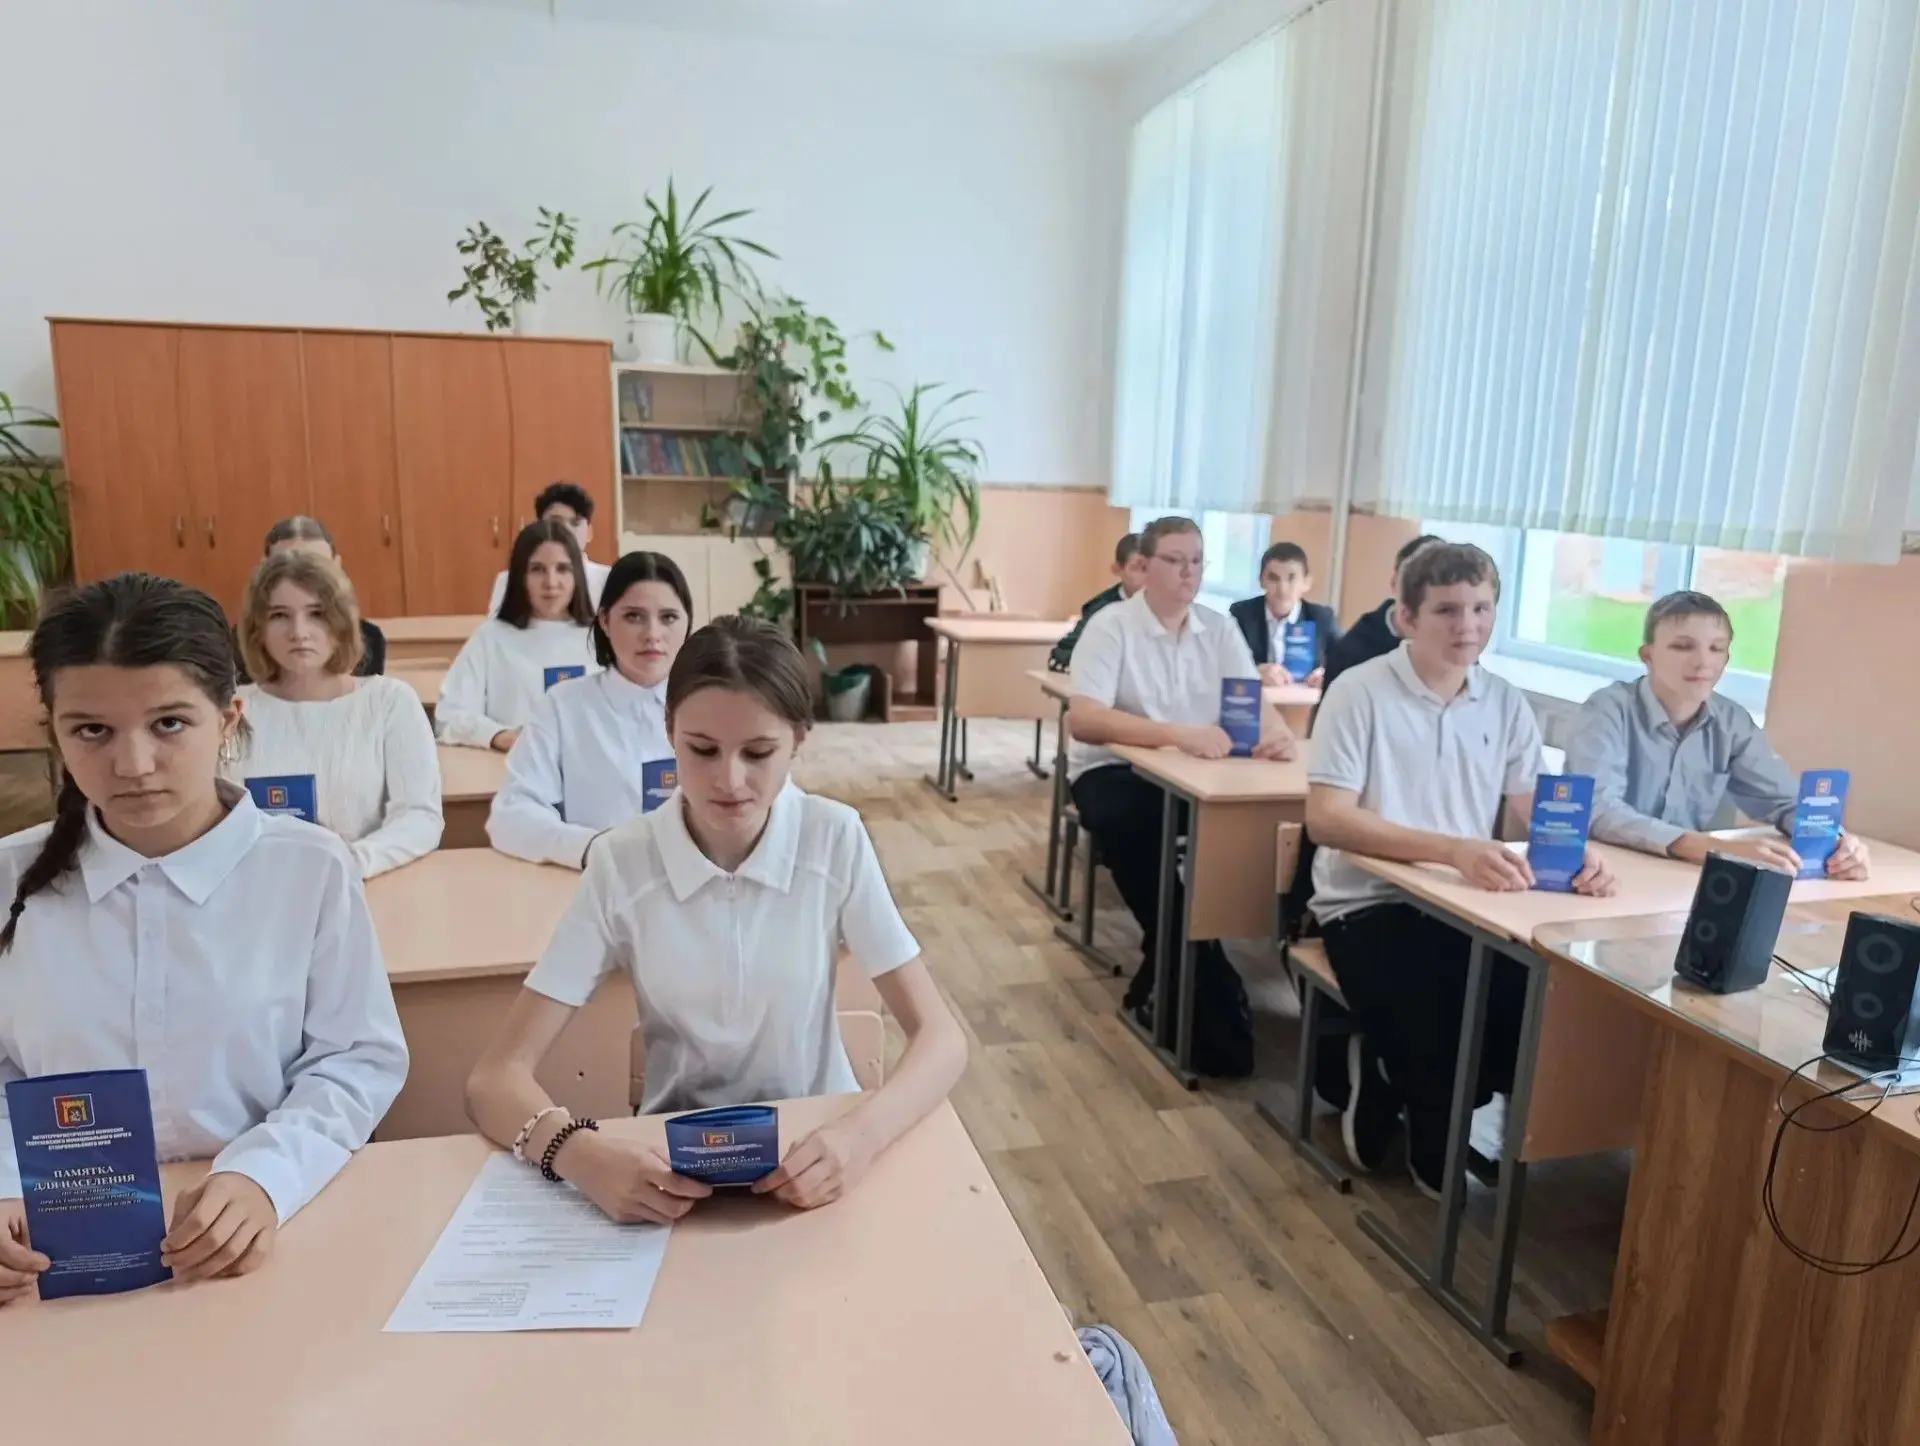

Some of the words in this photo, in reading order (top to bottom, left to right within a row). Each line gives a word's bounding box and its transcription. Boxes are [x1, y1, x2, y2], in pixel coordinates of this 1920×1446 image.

[54, 1166, 114, 1178] ПАМЯТКА
[33, 1181, 59, 1191] ДЛЯ
[61, 1174, 136, 1188] НАСЕЛЕНИЯ
